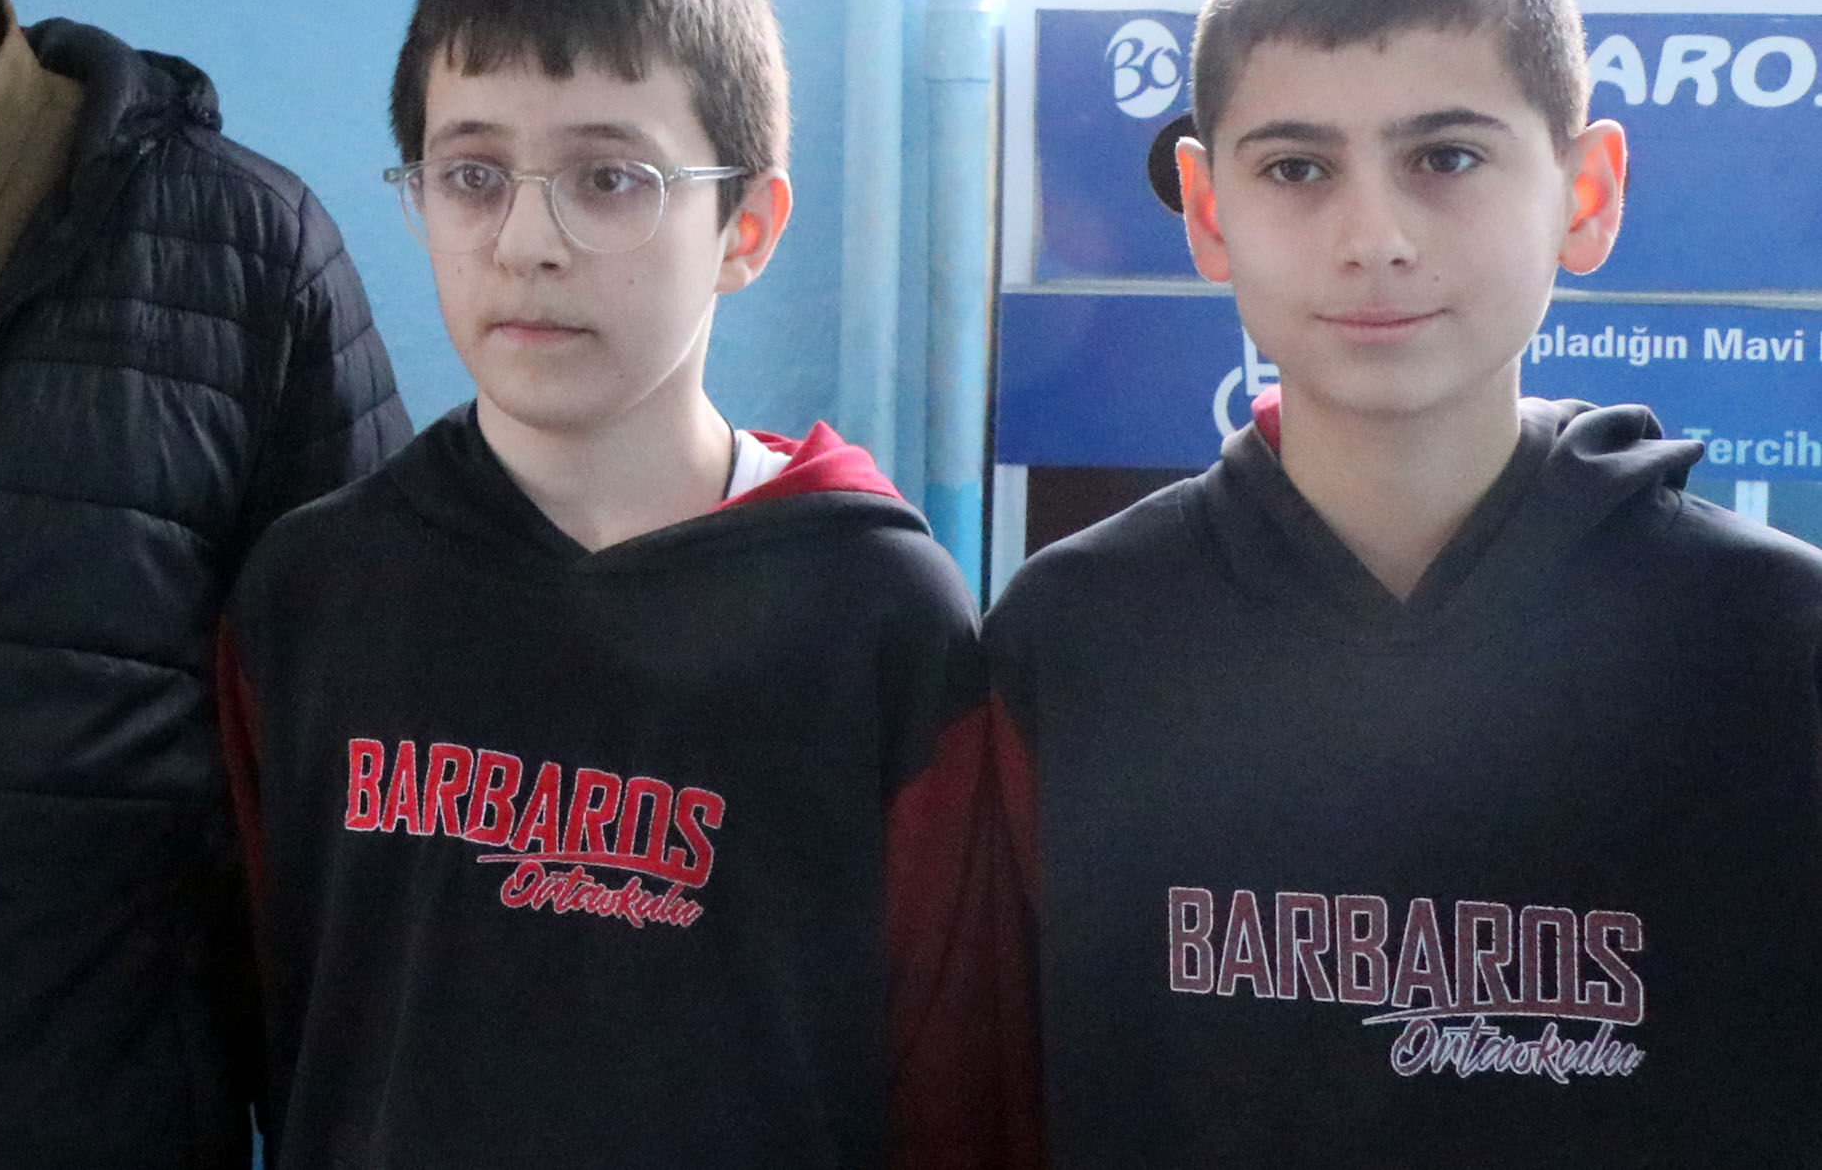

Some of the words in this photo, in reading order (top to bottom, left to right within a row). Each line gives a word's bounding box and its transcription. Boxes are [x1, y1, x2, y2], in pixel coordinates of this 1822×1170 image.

[1585, 34, 1822, 108] ARO
[1523, 325, 1688, 367] pladığın
[1703, 327, 1805, 362] Mavi
[345, 737, 726, 889] BARBAROS
[1168, 886, 1644, 1027] BARBAROS
